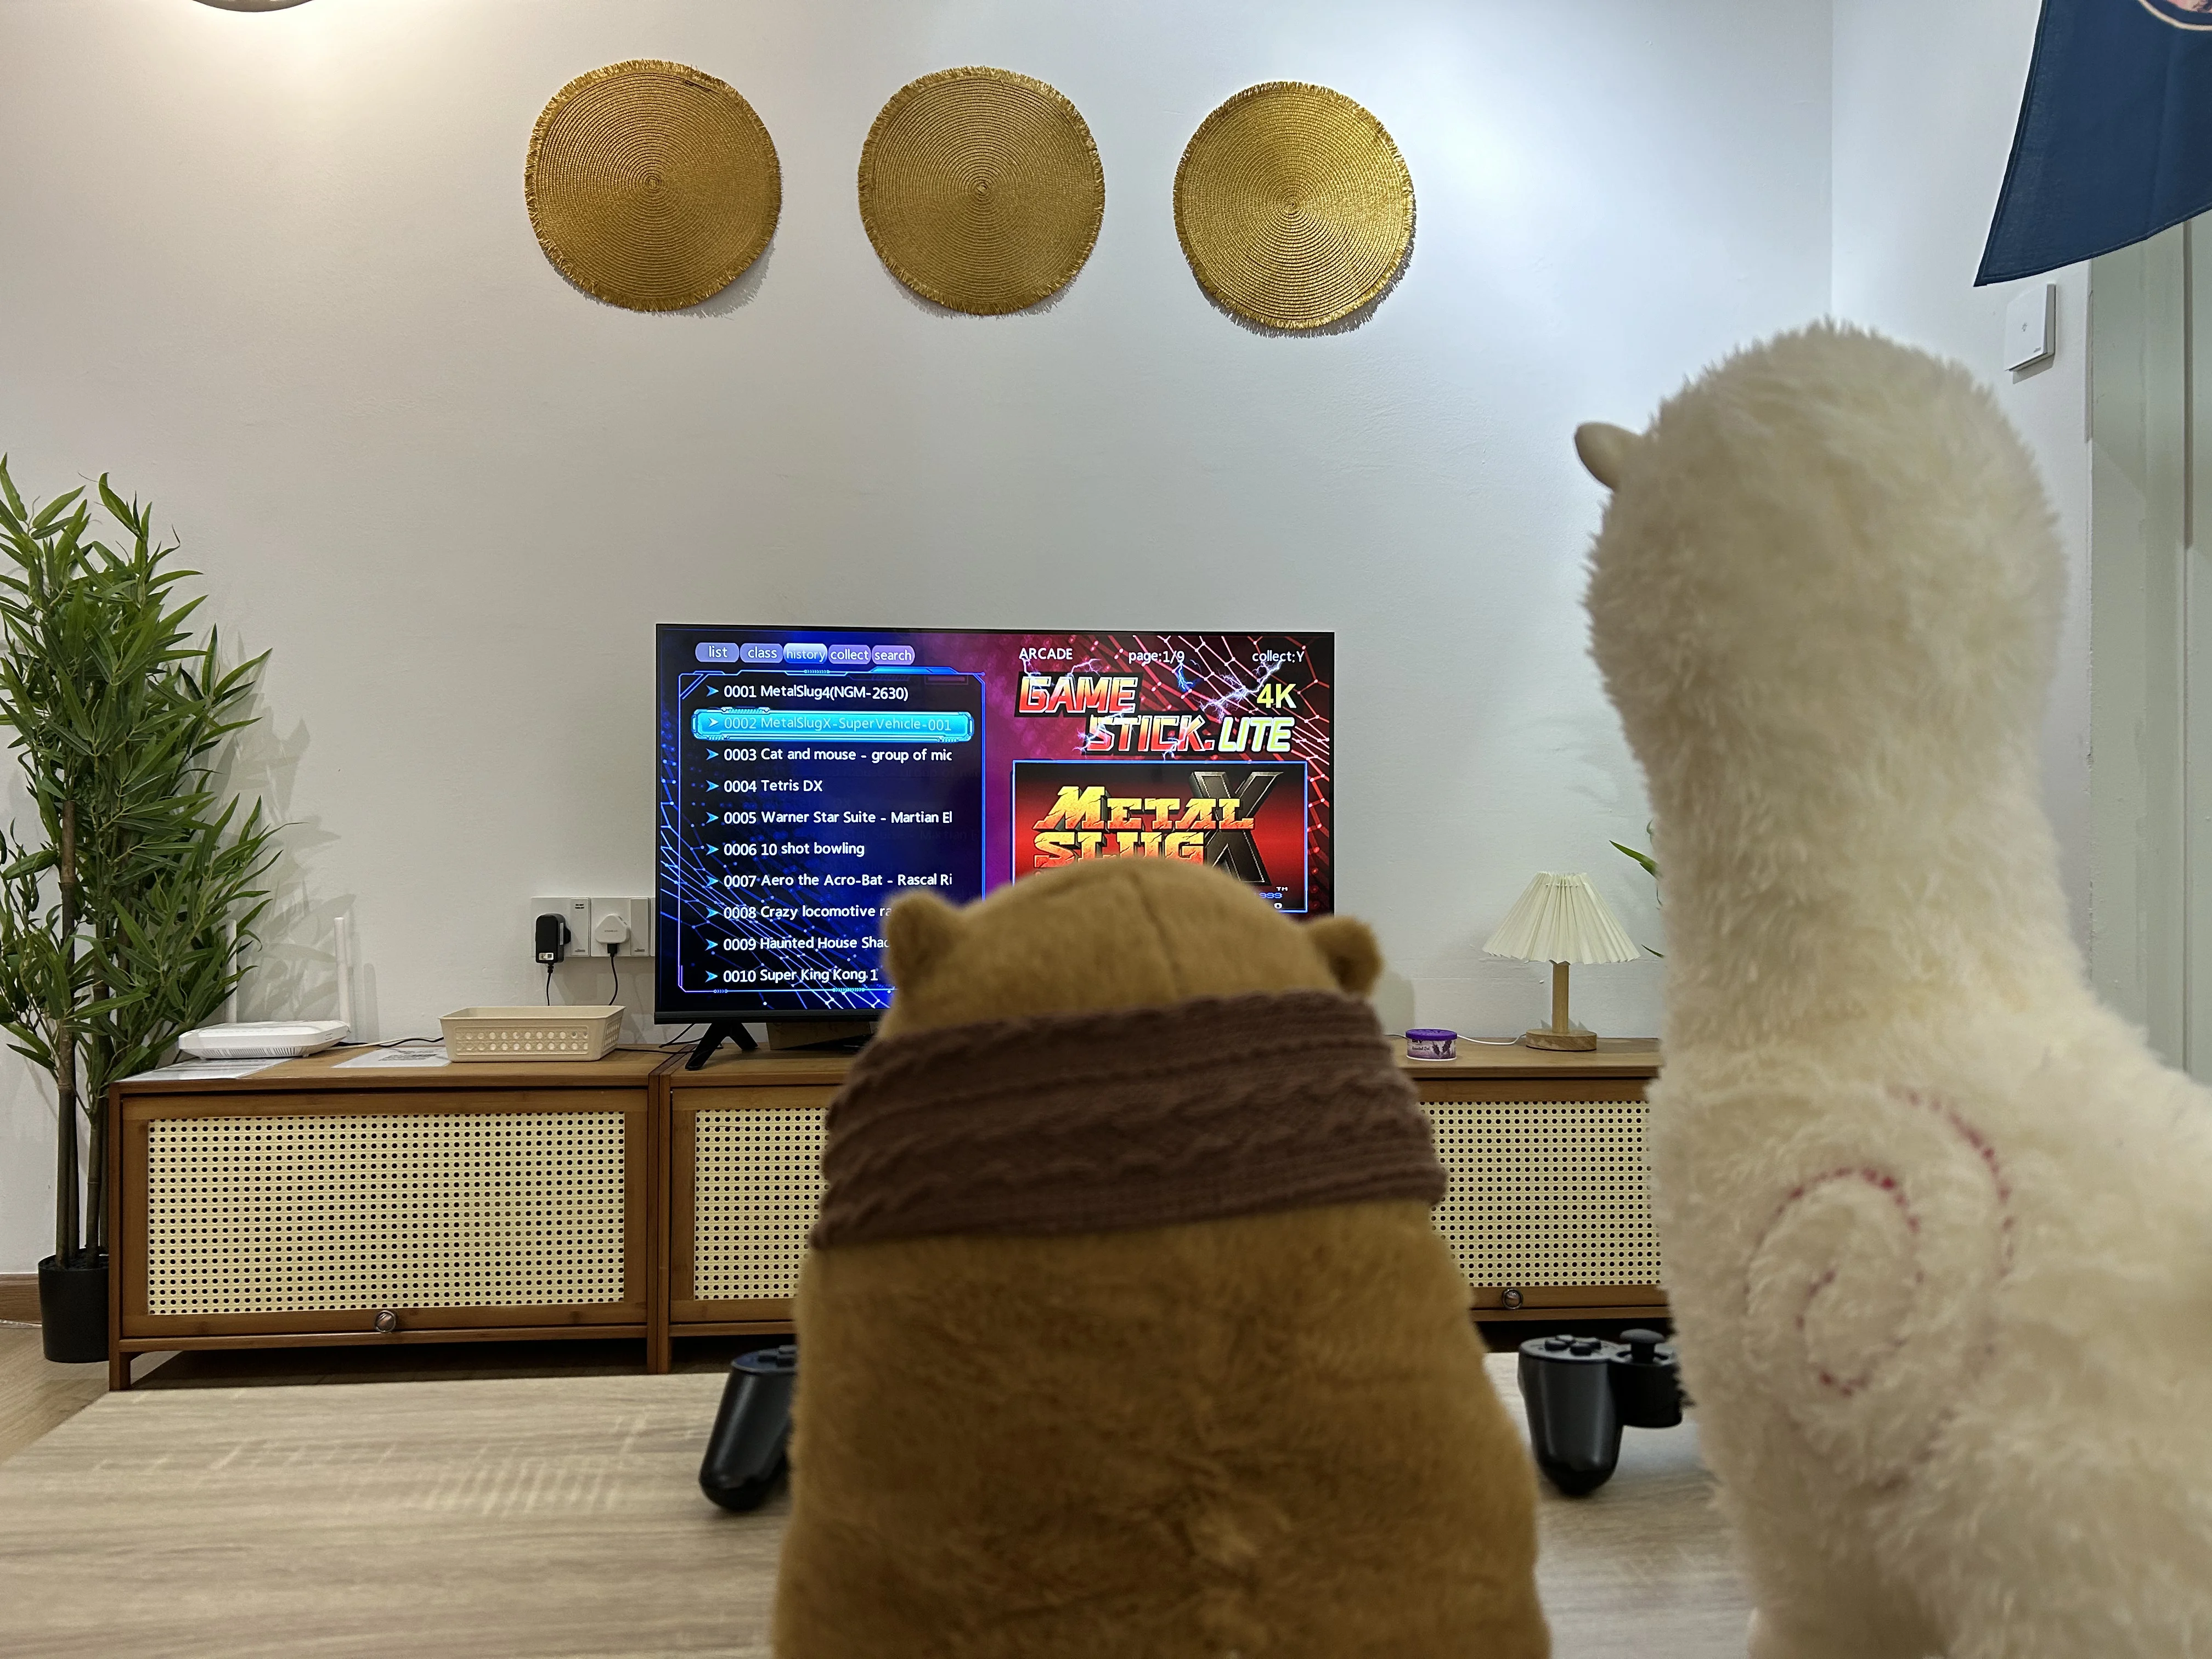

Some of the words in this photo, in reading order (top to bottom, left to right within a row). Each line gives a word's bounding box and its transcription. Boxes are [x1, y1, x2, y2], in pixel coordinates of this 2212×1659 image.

[709, 646, 727, 658] list
[748, 646, 777, 658] class
[786, 650, 825, 662] history
[830, 648, 868, 660] collect
[874, 650, 912, 661] search
[1019, 648, 1073, 659] ARCADE
[1128, 651, 1185, 664] page:1/9
[1252, 650, 1305, 663] collect:Y
[724, 685, 757, 698] 0001
[761, 685, 909, 701] MetalSlug4(NGM-2630)
[1019, 676, 1138, 713] GAME
[1257, 684, 1296, 708] 4K
[724, 716, 757, 730] 0002
[724, 748, 757, 761] 0003
[761, 748, 782, 760] Cat
[787, 748, 810, 760] and
[814, 750, 856, 760] mouse
[871, 750, 909, 763] group
[913, 748, 927, 761] of
[931, 748, 952, 761] mic
[724, 780, 757, 792] 0004
[761, 780, 799, 792] Tetris
[803, 780, 823, 792] DX
[1032, 786, 1254, 829] METAL
[724, 812, 757, 824] 0005
[761, 812, 809, 823] Warner
[813, 811, 839, 823] Star
[843, 811, 876, 823] Suite
[891, 811, 939, 823] Martian
[1189, 771, 1284, 885] X
[724, 844, 757, 856] 0006
[761, 844, 777, 855] 10
[781, 842, 809, 854] shot
[814, 842, 865, 857] bowling
[724, 875, 757, 887] 0007
[761, 874, 794, 886] Aero
[798, 874, 819, 885] the
[824, 874, 882, 885] Acro-Bat
[898, 873, 938, 885] Rascal
[940, 873, 952, 885] Ri
[724, 906, 757, 919] 0008
[760, 906, 798, 920] Crazy
[802, 905, 876, 917] locomotive
[723, 939, 756, 950] 0009
[760, 936, 814, 949] Haunted
[818, 938, 857, 949] House
[723, 970, 756, 982] 0010
[760, 969, 797, 983] Super
[801, 969, 830, 983] King
[833, 969, 867, 983] Kong
[870, 969, 878, 980] 1
